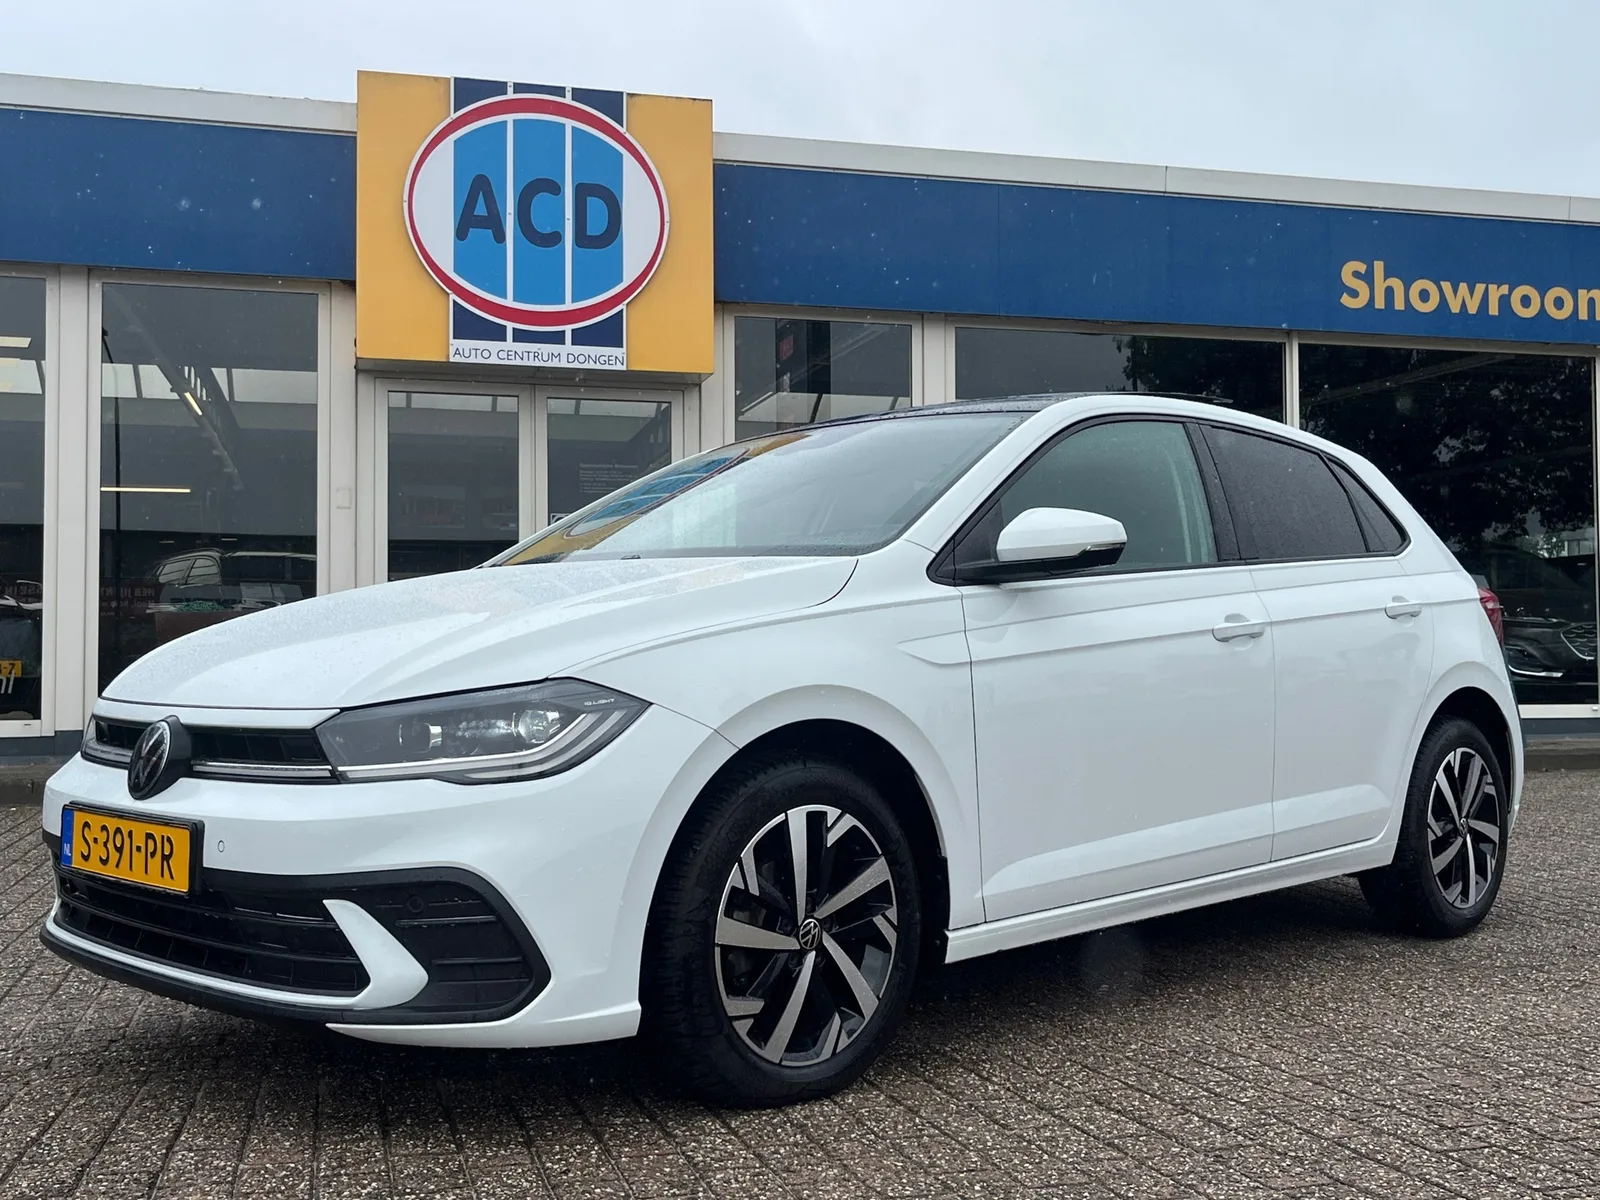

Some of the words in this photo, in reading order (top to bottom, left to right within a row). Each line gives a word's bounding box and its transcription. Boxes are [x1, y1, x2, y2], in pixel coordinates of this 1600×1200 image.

[455, 173, 622, 250] ACD
[453, 347, 492, 361] AUTO
[497, 349, 561, 364] CENTRUM
[567, 352, 624, 366] DONGEN
[64, 843, 72, 857] NL
[80, 820, 175, 880] S-391-PR
